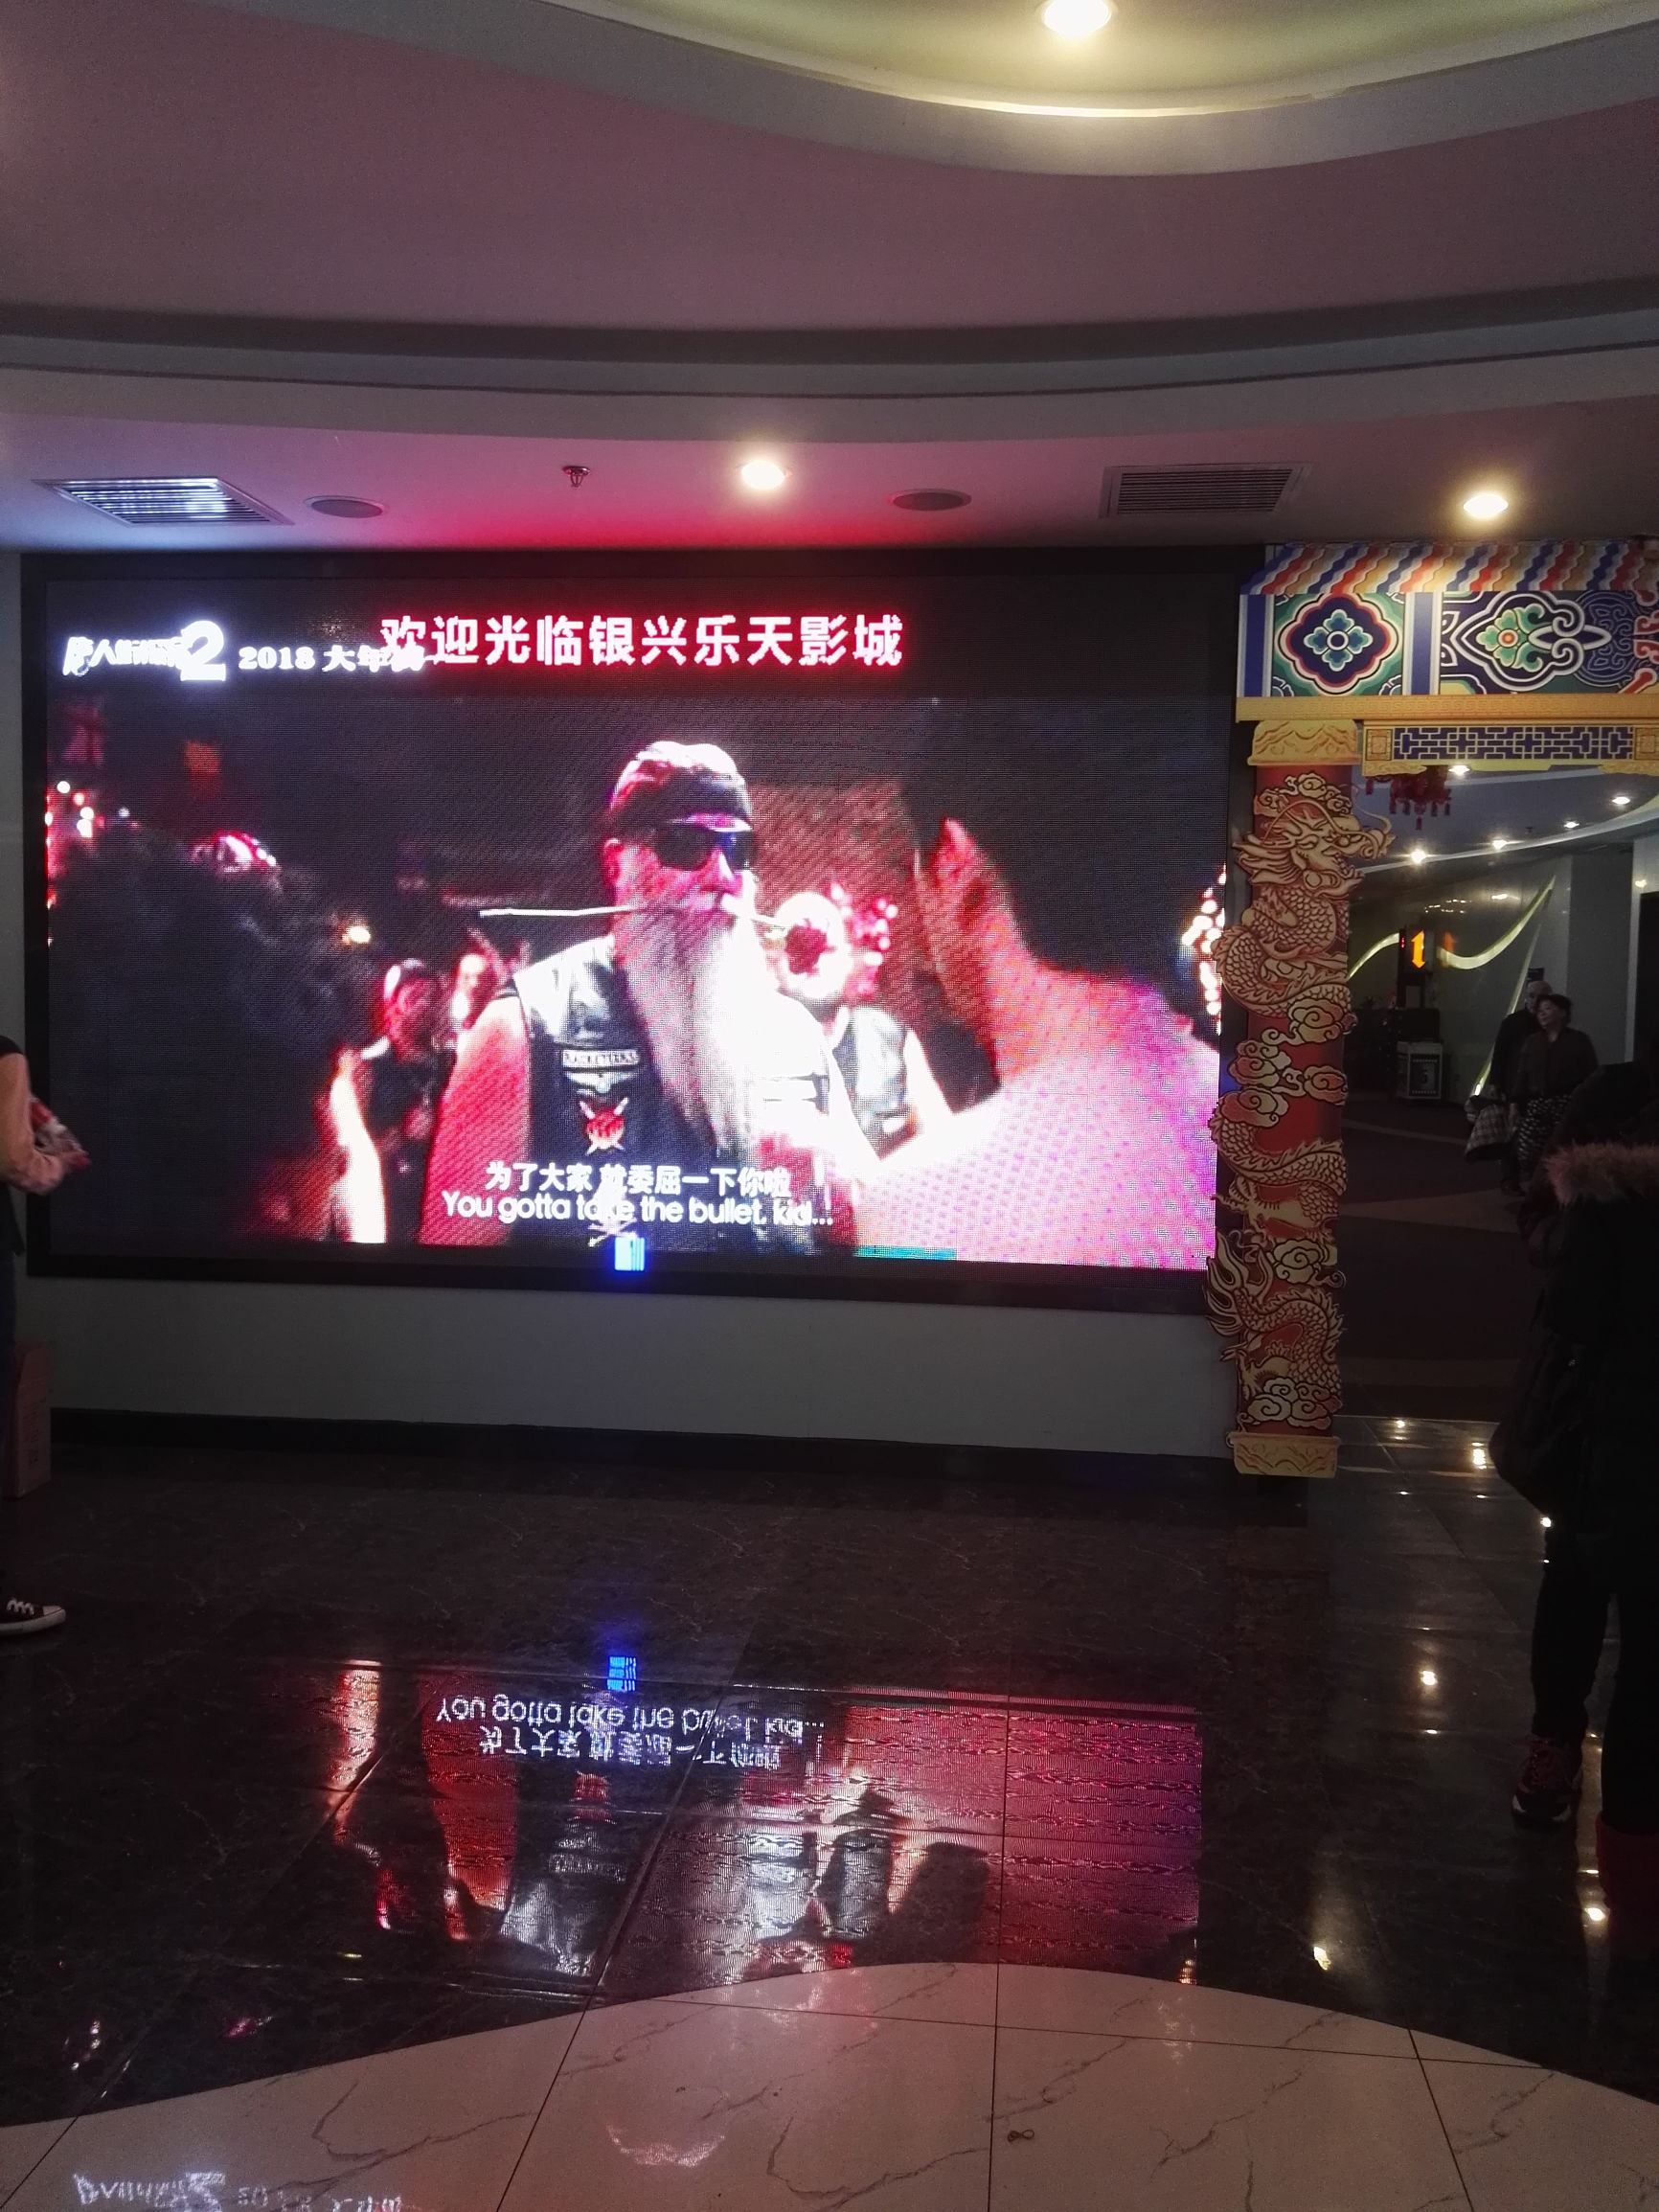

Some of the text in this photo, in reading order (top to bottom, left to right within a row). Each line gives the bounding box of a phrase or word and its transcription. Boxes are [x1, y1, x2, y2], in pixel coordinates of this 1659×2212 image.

[380, 614, 903, 668] 欢迎光临银兴乐天影城
[238, 646, 316, 670] 2018
[442, 1190, 492, 1218] You
[497, 1192, 571, 1223] gotta
[640, 1196, 684, 1221] the
